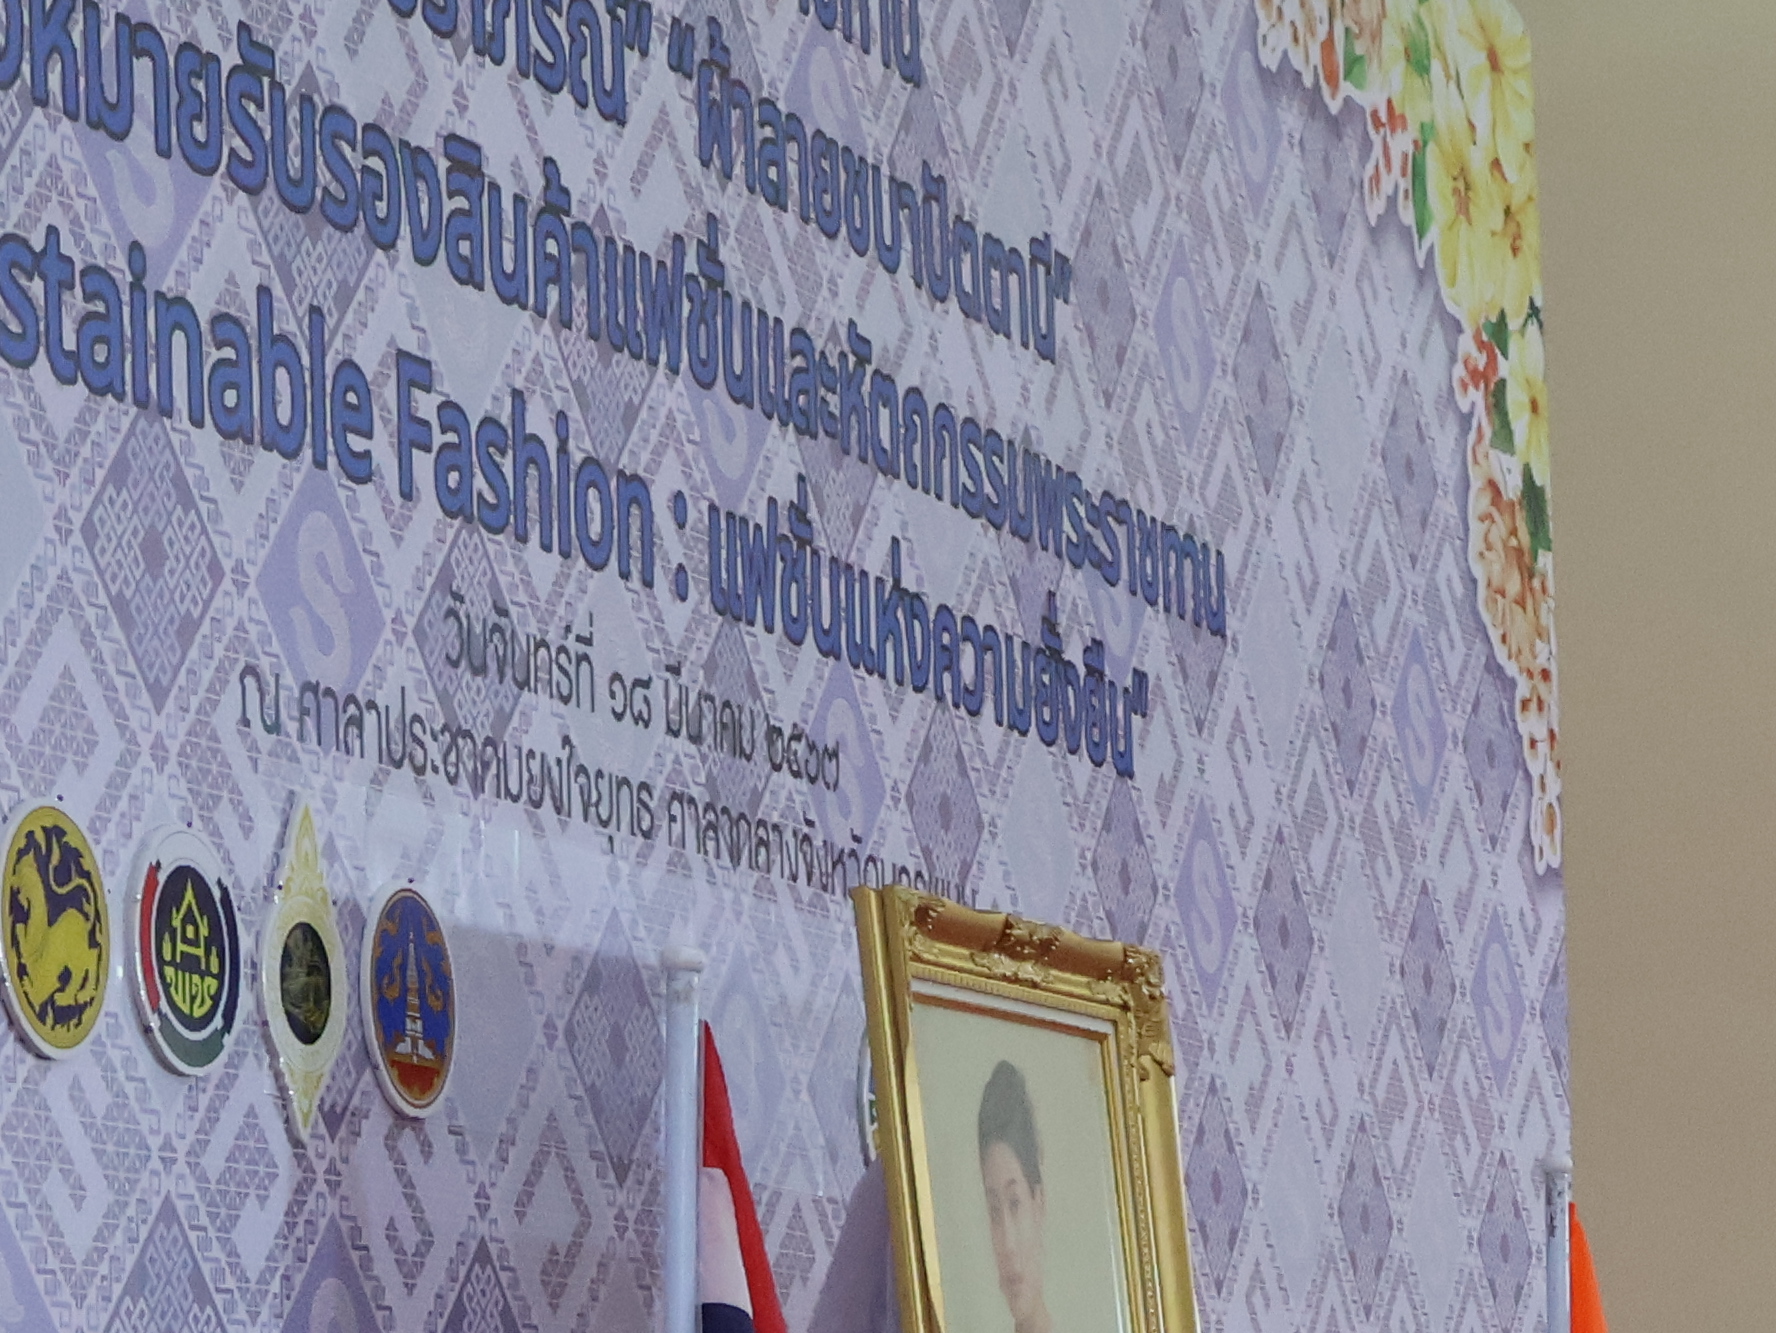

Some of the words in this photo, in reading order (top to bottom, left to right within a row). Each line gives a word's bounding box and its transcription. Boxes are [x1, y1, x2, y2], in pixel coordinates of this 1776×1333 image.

[0, 223, 375, 486] stainable
[397, 348, 654, 592] Fashion
[442, 582, 596, 714] วันจันทร์ที่
[608, 670, 653, 729] ๑๘
[663, 660, 757, 764] มีนาคม
